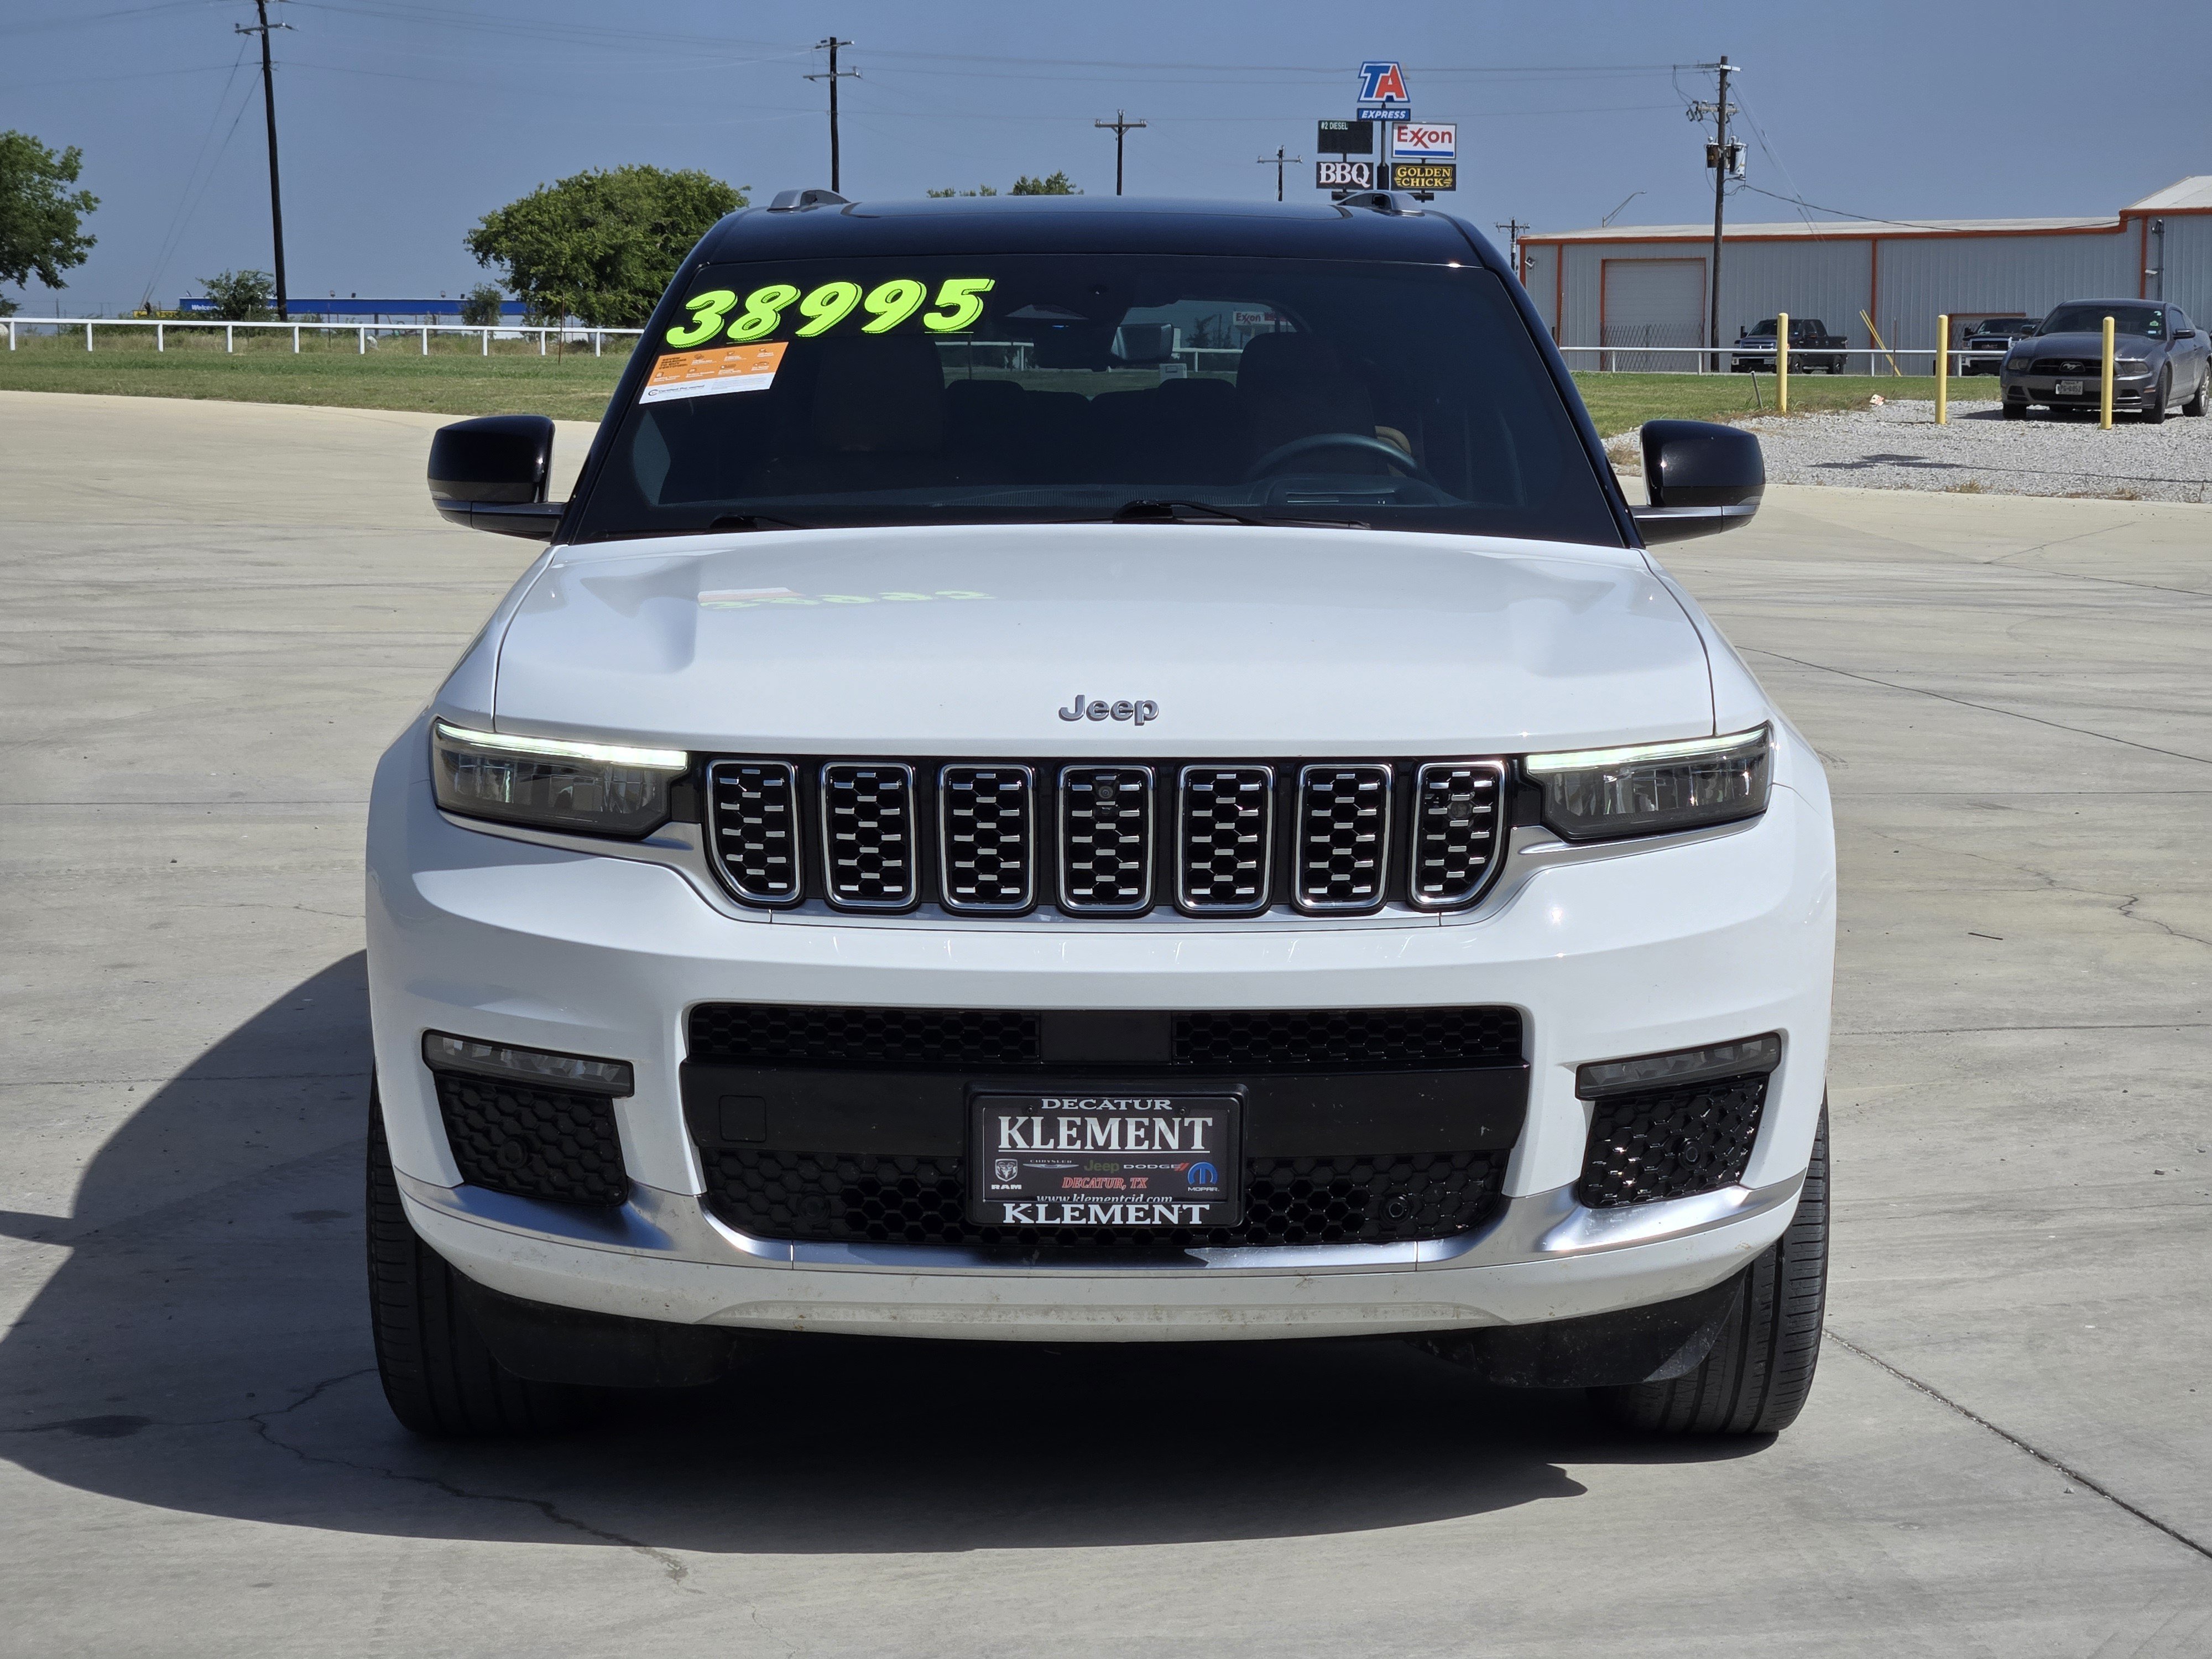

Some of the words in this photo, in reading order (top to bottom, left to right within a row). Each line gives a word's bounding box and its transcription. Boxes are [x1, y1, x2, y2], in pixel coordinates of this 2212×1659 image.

[1360, 63, 1408, 101] TA
[1361, 111, 1406, 119] EXPRESS
[1397, 126, 1452, 149] Exxon
[1319, 163, 1370, 187] BBQ
[1397, 168, 1451, 177] GOLDEN
[1401, 178, 1444, 187] CHICK
[666, 279, 995, 349] 38995
[1236, 312, 1261, 325] Exxon
[1058, 695, 1160, 726] Jeep
[1041, 1099, 1173, 1110] DECATUR
[998, 1116, 1213, 1150] KLEMENT
[1084, 1160, 1119, 1173] Jeep
[1062, 1177, 1126, 1191] DECATUR,
[1130, 1177, 1149, 1188] TX
[1003, 1203, 1210, 1224] KLEMENT
